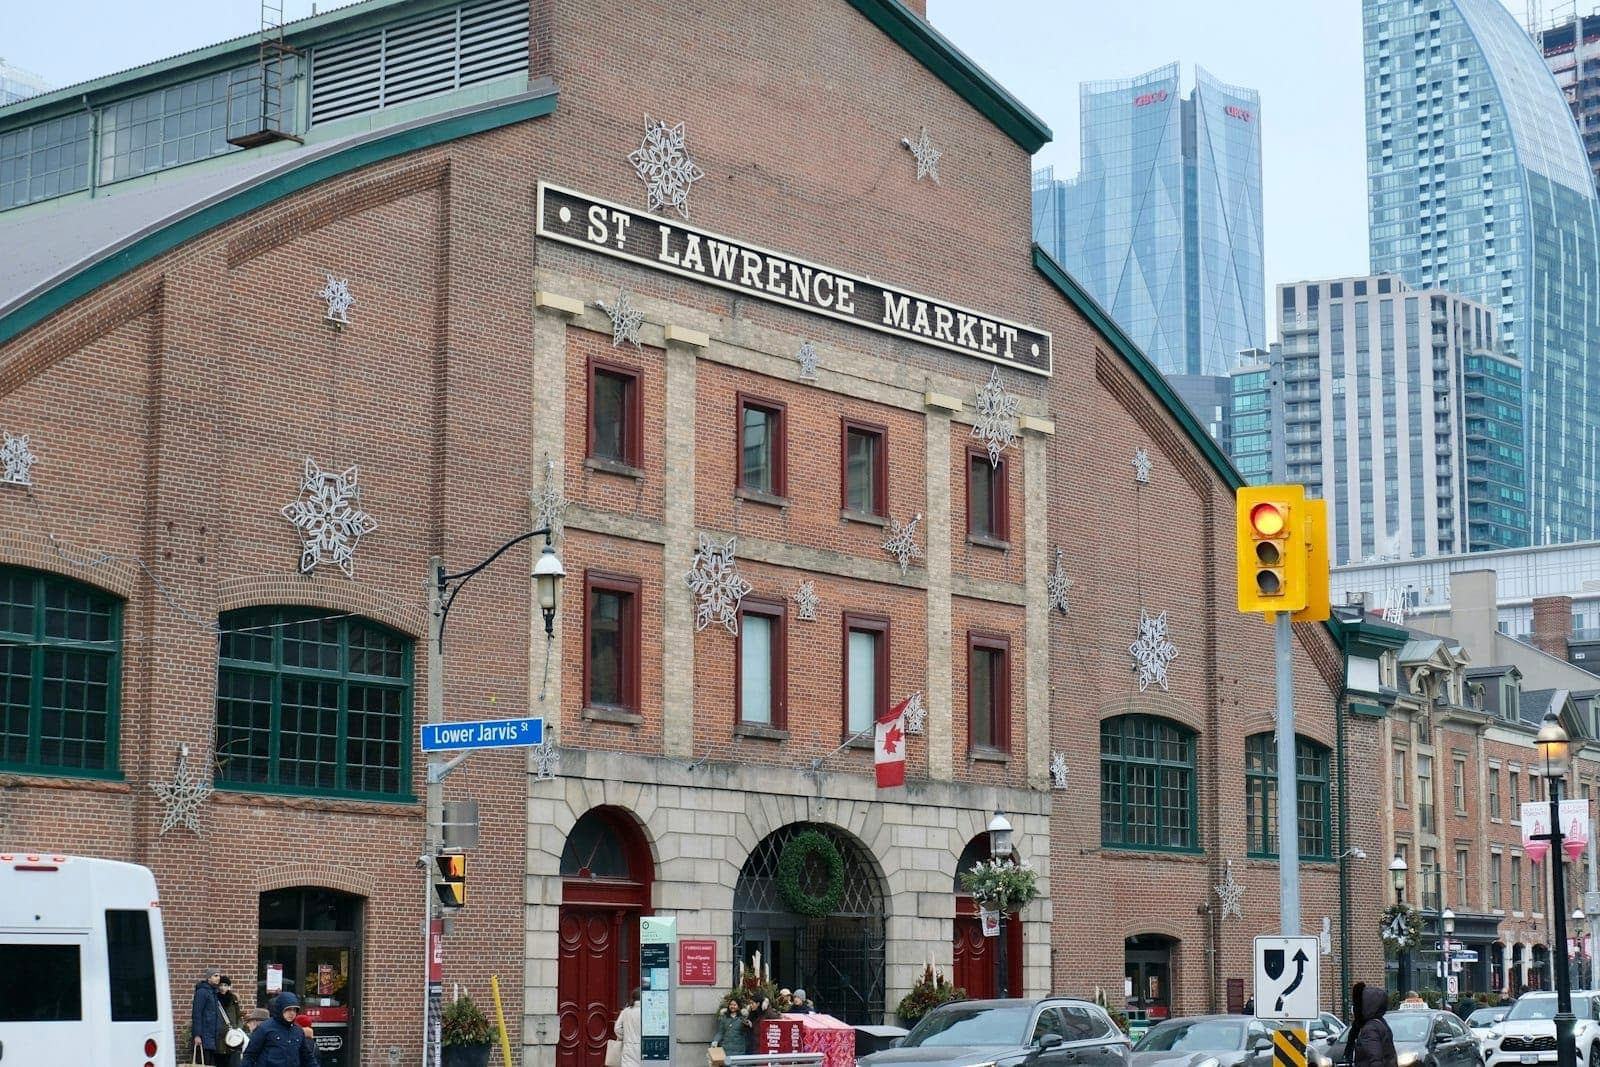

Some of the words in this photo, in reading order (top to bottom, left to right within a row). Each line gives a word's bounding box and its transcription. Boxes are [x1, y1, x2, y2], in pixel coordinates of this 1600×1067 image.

[658, 225, 855, 314] LAWRENCE
[882, 291, 1018, 360] MARKET
[434, 726, 474, 744] Lower
[477, 722, 518, 742] Jarvis
[520, 721, 529, 732] St
